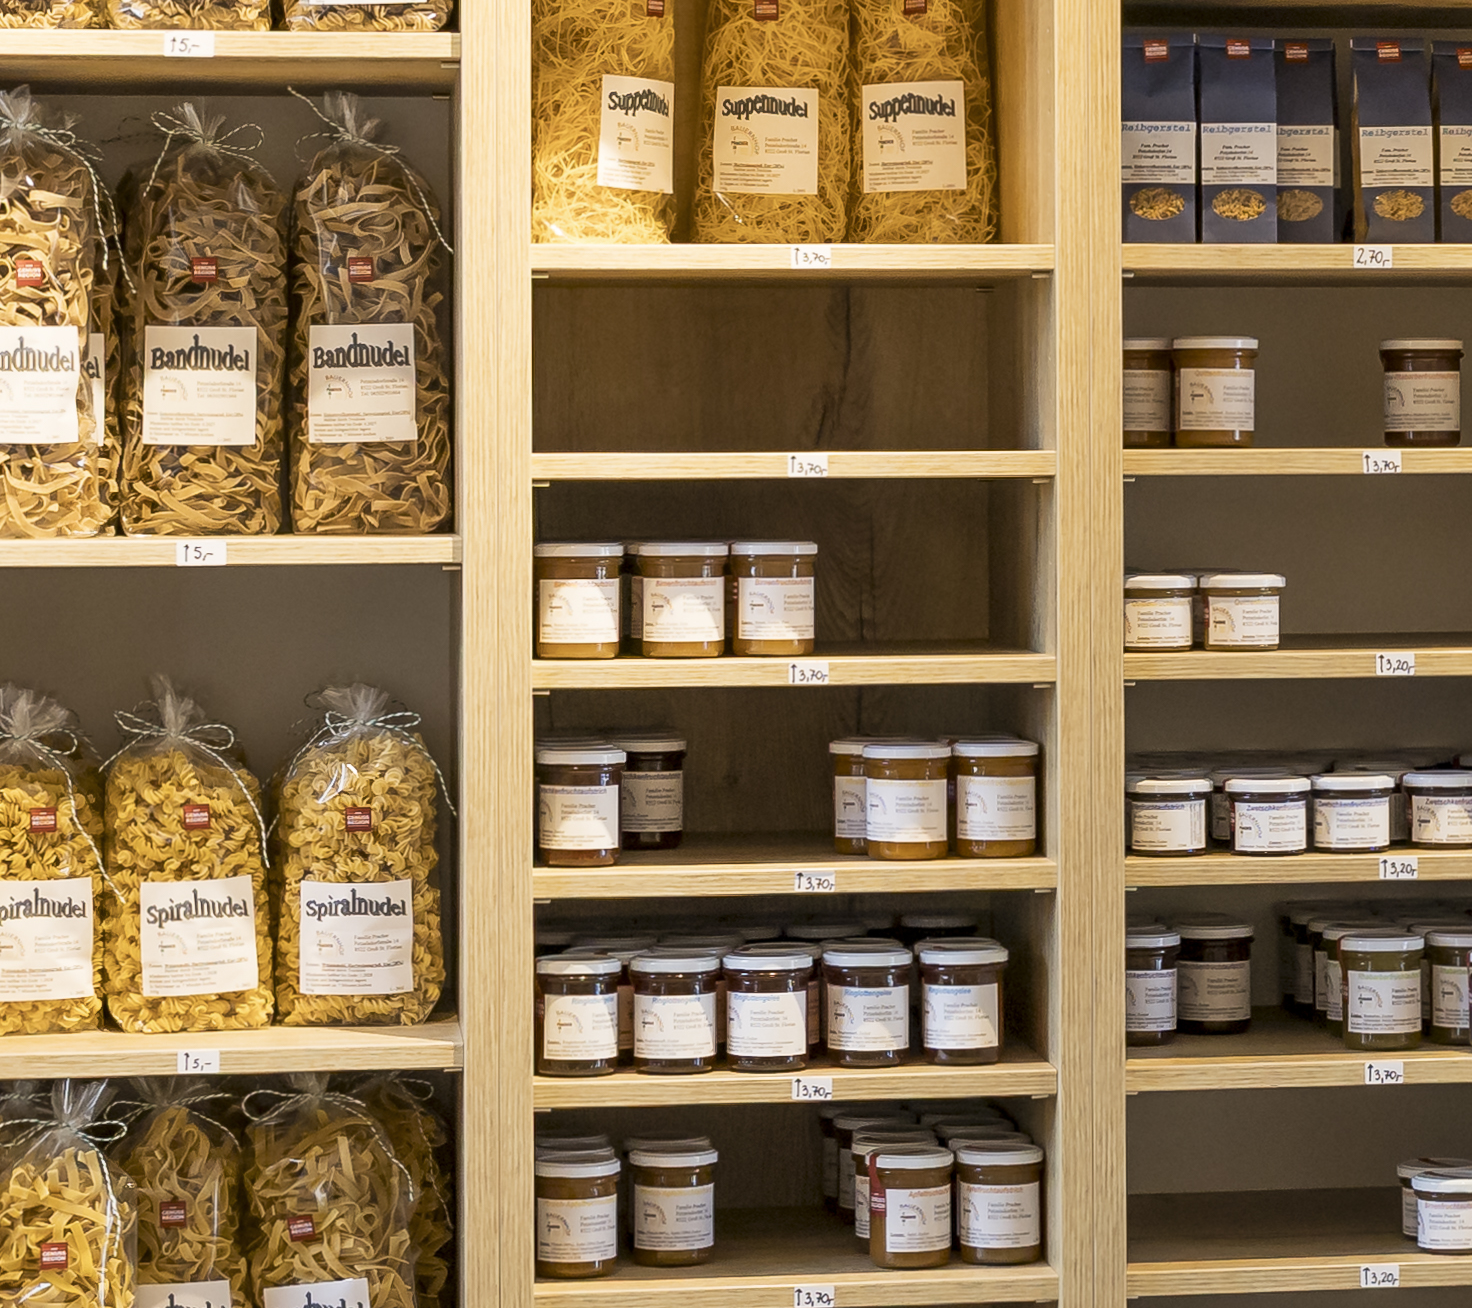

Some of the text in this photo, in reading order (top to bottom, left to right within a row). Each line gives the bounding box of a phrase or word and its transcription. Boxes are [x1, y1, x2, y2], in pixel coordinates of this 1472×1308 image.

[608, 89, 670, 118] Suppennudel
[721, 94, 808, 120] Suppennudel
[868, 92, 956, 122] Suppennudel
[1202, 125, 1272, 136] Reibgerstel
[1361, 128, 1430, 139] Reibgerstel
[150, 334, 250, 372] Bandnudel
[312, 332, 411, 369] Bandnudel
[147, 888, 250, 929] Spiralnudel
[305, 888, 407, 922] Spiralnudel
